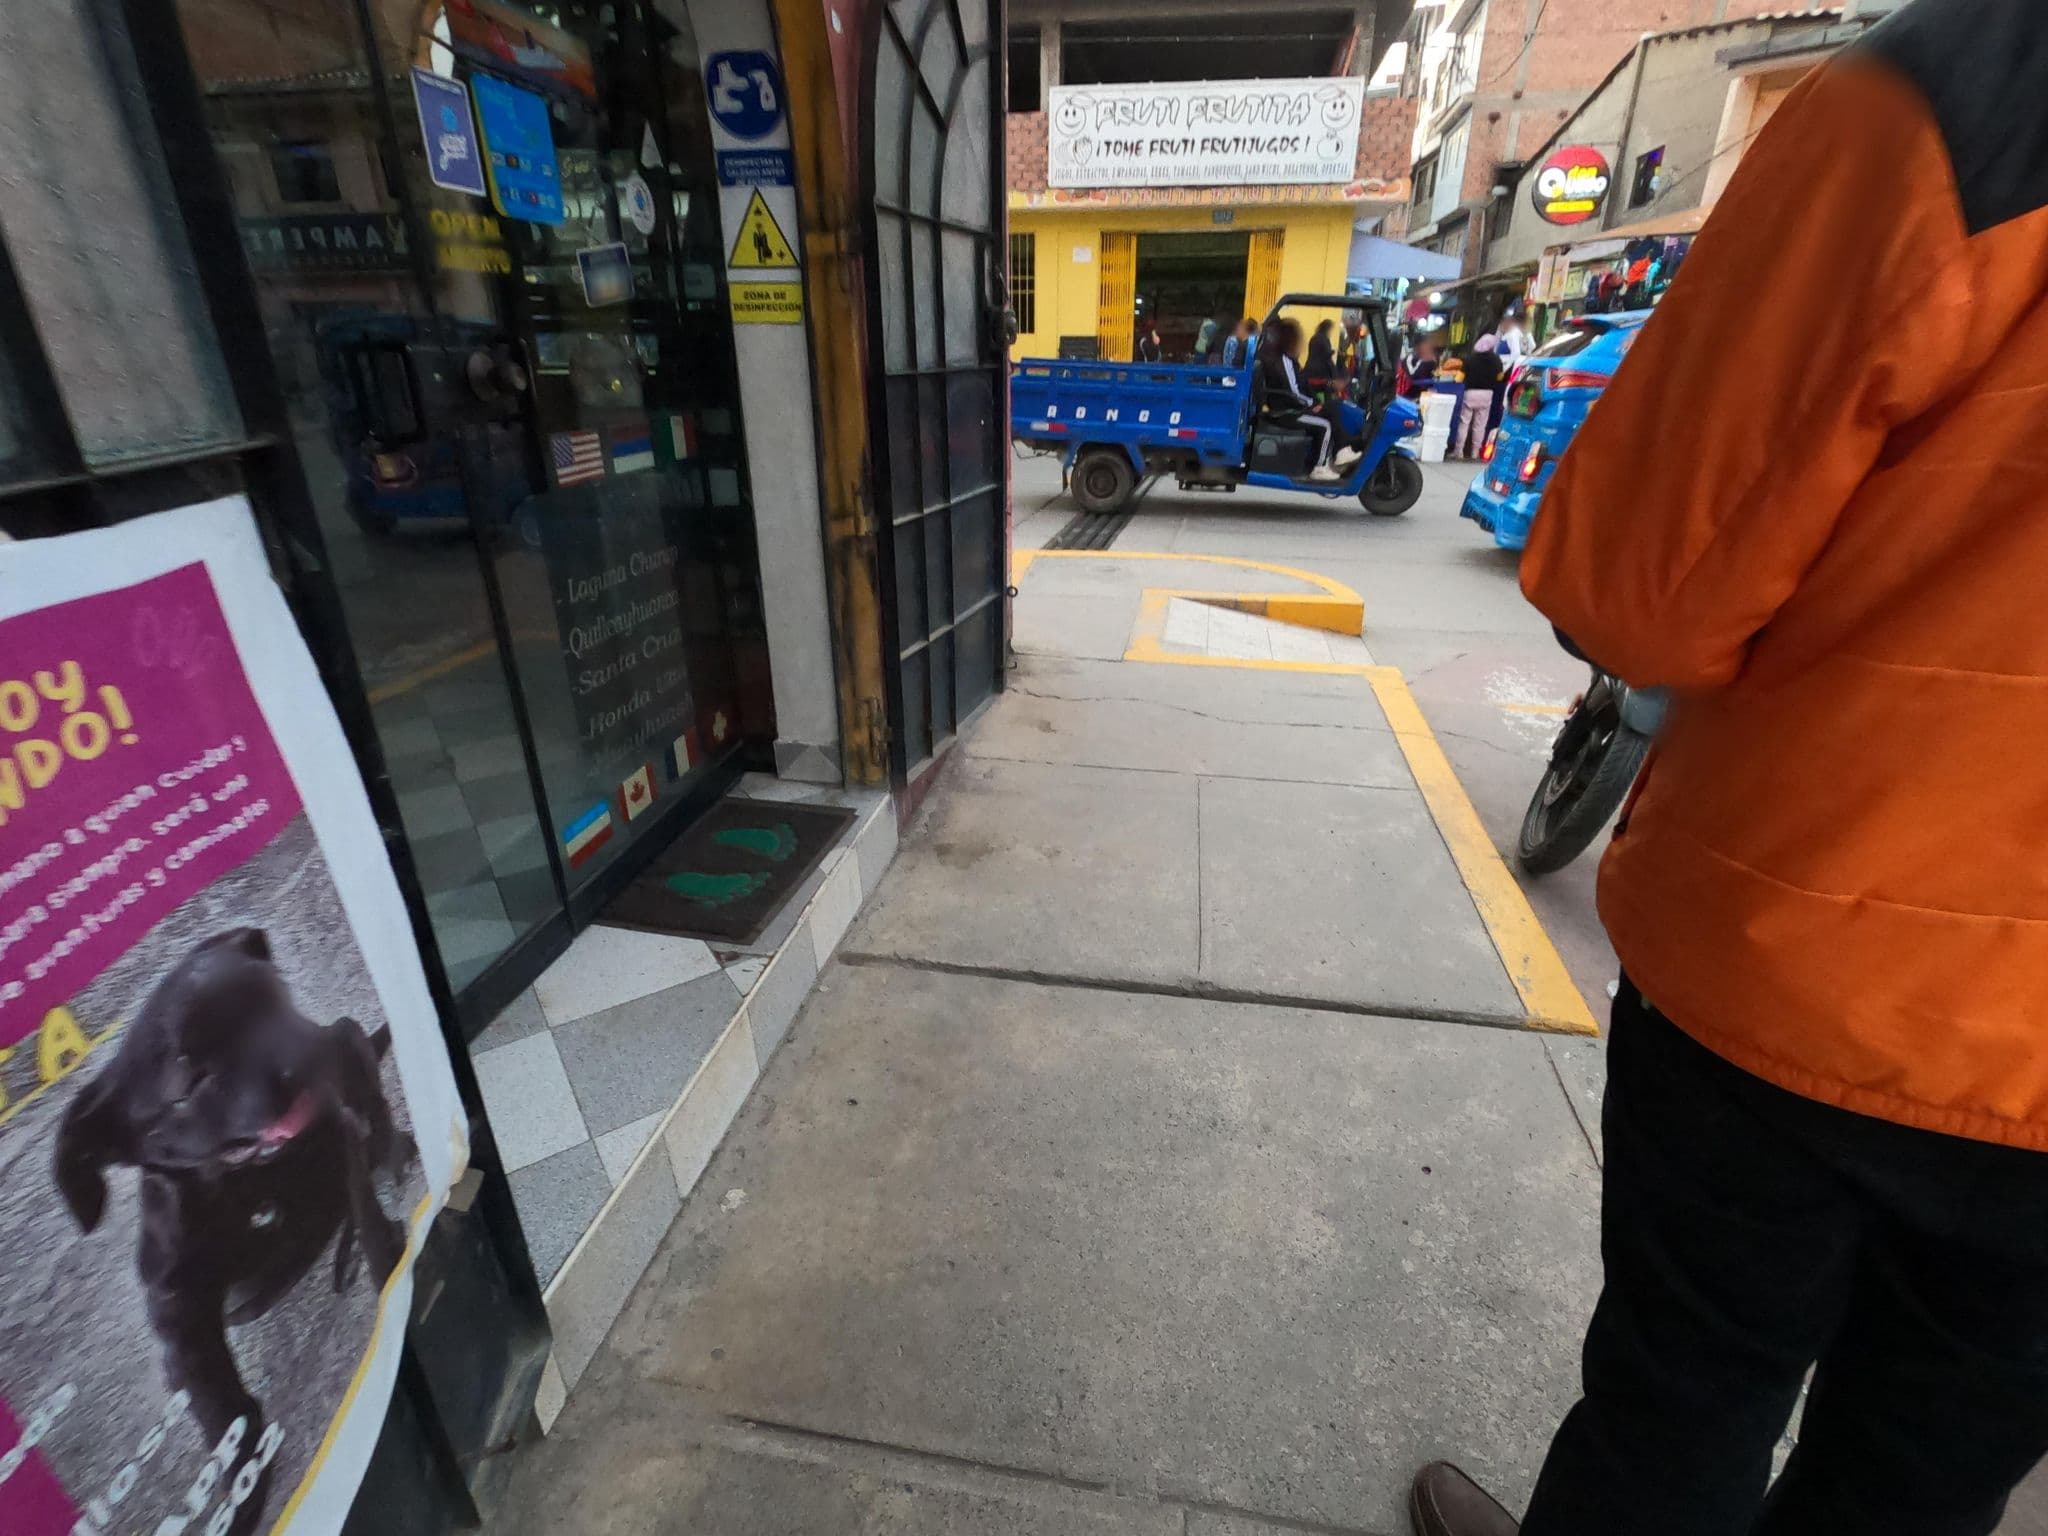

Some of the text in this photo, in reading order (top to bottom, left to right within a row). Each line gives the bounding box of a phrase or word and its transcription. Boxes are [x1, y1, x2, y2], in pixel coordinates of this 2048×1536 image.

[1094, 93, 1312, 131] FRUTI FRUTITA
[1148, 136, 1196, 157] FRUTI
[743, 290, 787, 301] ZONA DE
[151, 791, 209, 836] será
[144, 867, 167, 887] y
